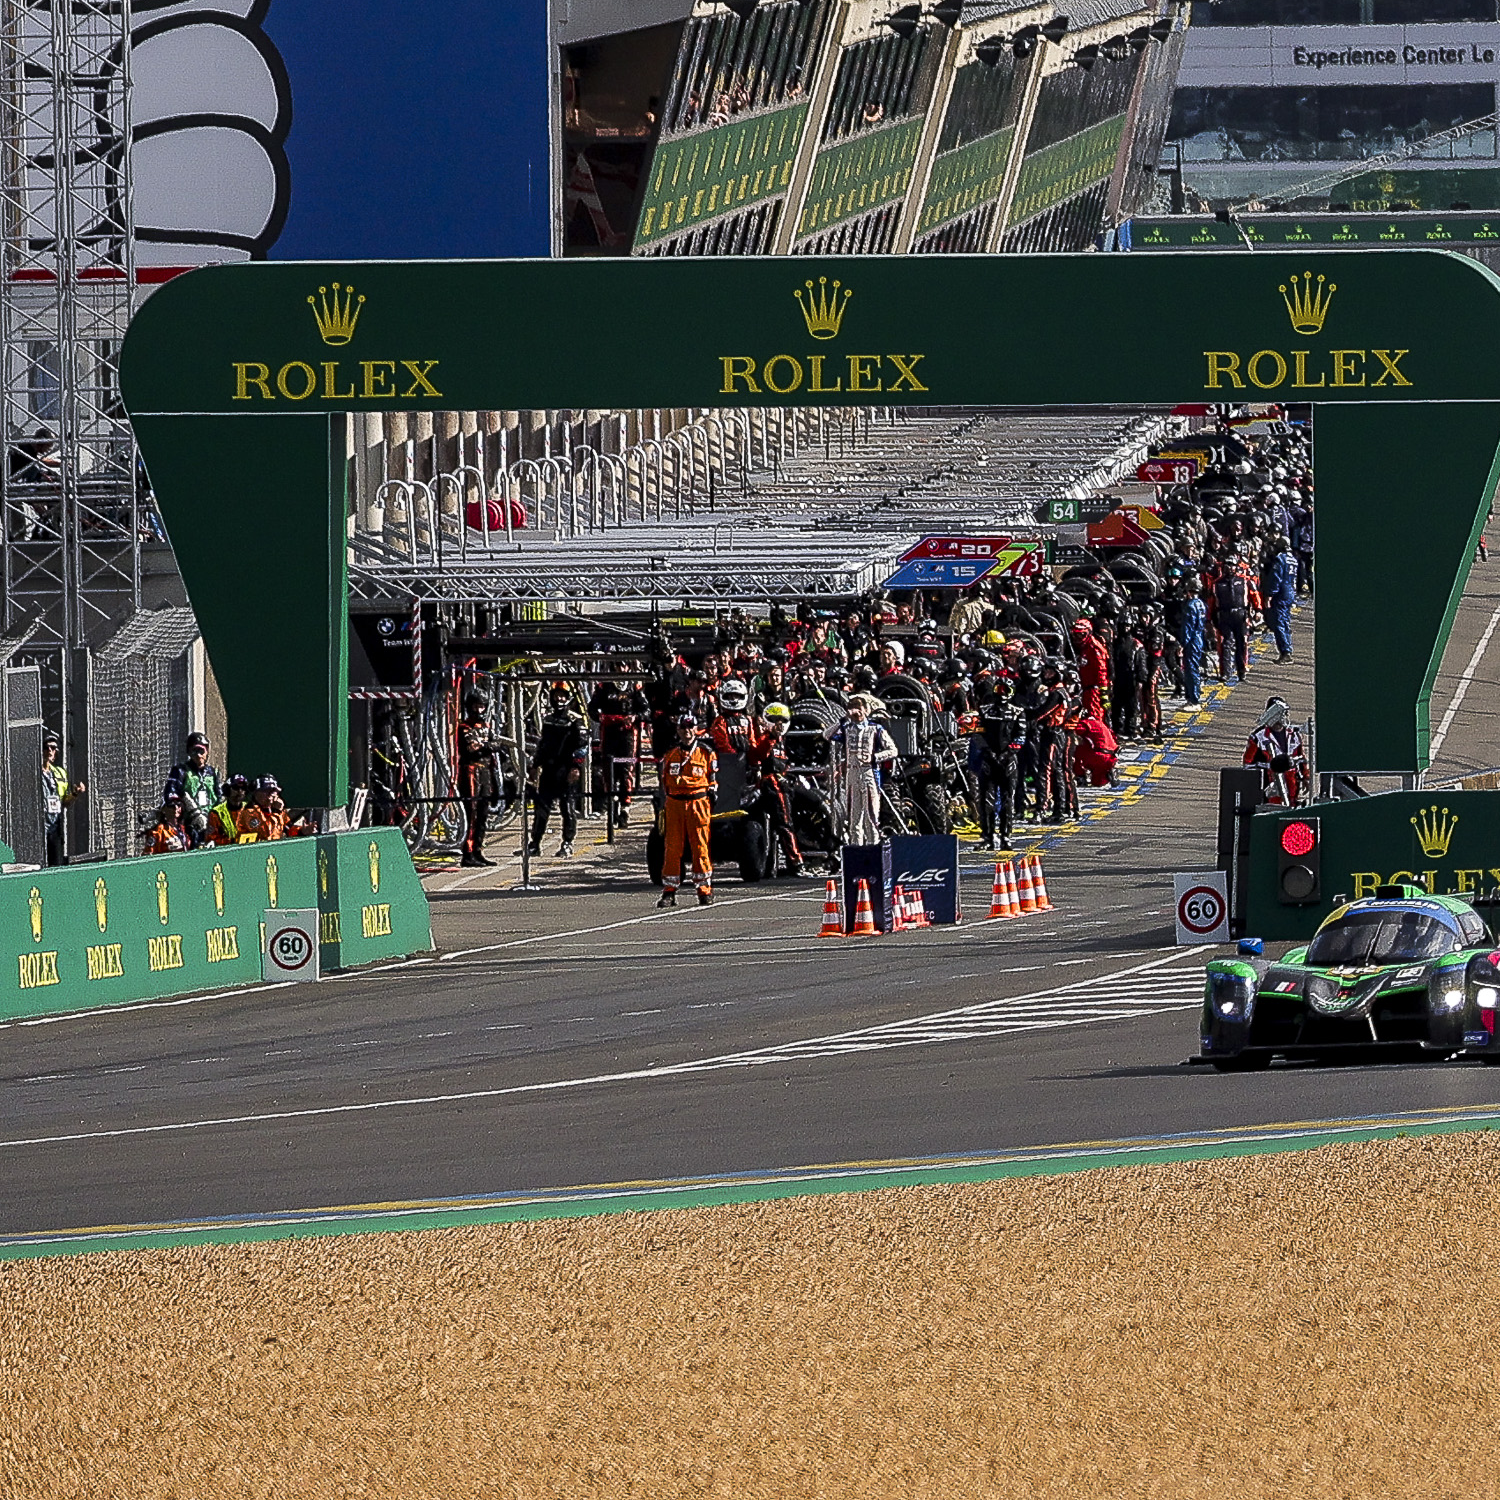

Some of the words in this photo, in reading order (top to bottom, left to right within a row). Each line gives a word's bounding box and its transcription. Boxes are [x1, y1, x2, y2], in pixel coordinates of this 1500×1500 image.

[1293, 44, 1396, 69] Experience
[1402, 44, 1466, 66] Center
[1471, 43, 1494, 63] Le
[233, 361, 442, 399] ROLEX
[720, 355, 928, 392] ROLEX
[1204, 350, 1412, 388] ROLEX
[1172, 467, 1190, 484] 13
[1053, 503, 1076, 520] 54
[961, 544, 991, 555] 20
[951, 566, 976, 577] 15
[897, 867, 950, 883] WEC
[361, 903, 392, 939] ROLEX
[1187, 900, 1218, 921] 60
[148, 934, 185, 973] ROLEX
[205, 926, 240, 964] ROLEX
[279, 936, 303, 955] 60
[18, 951, 61, 990] ROLEX
[86, 943, 125, 981] ROLEX
